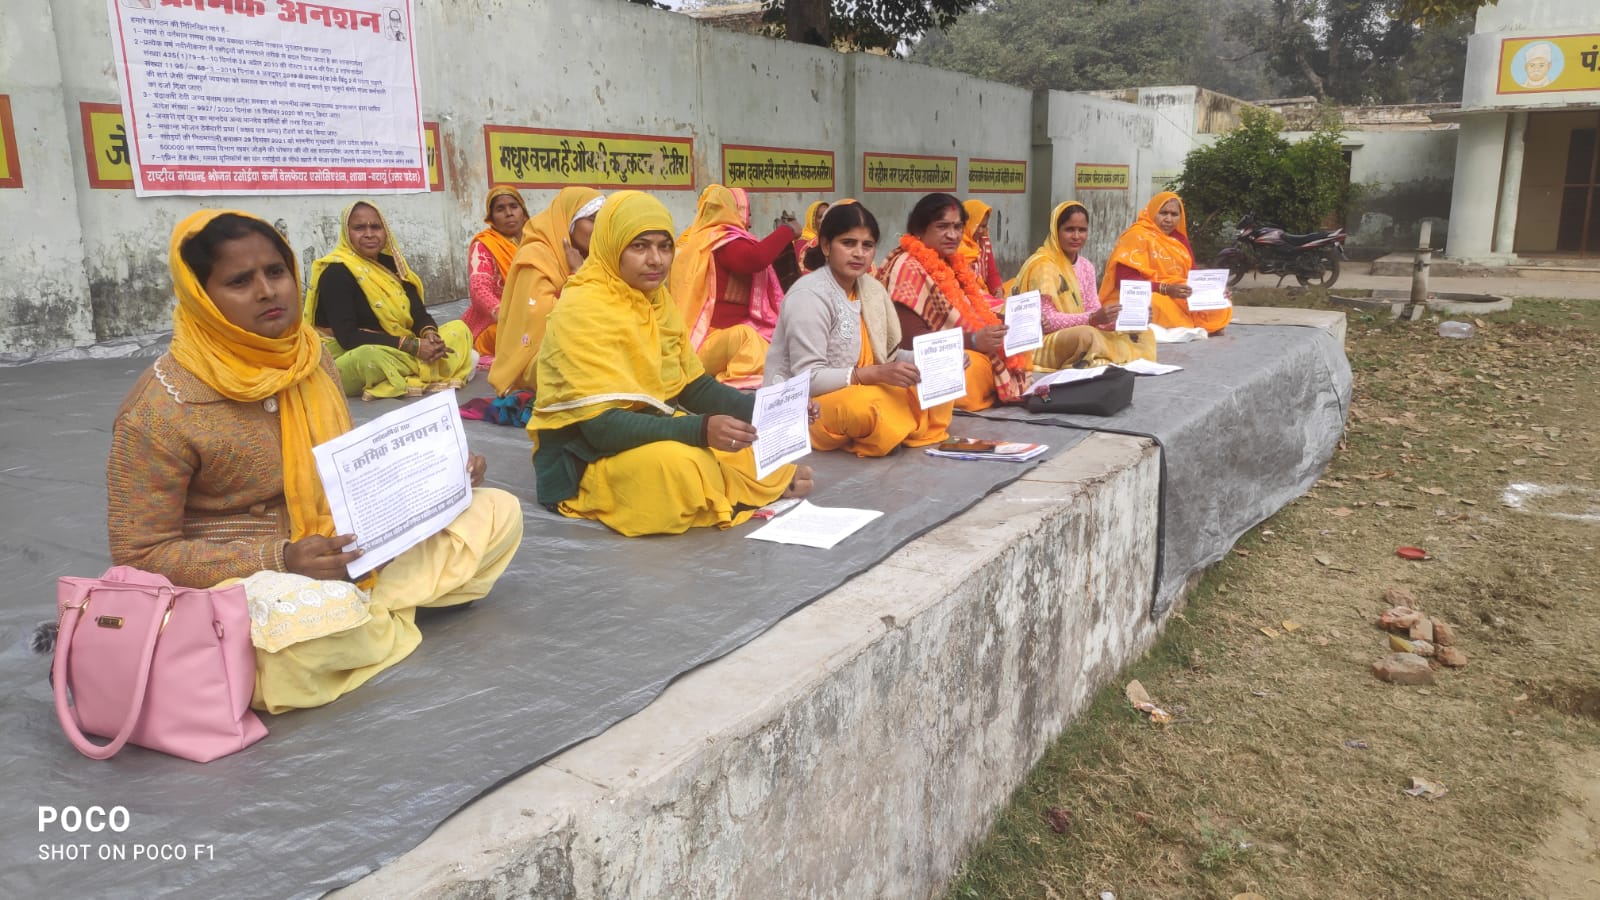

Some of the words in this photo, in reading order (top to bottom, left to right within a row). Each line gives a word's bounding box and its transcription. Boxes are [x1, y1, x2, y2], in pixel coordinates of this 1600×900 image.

[277, 0, 381, 33] अनशन
[146, 166, 175, 183] राष्ट्रीय
[176, 170, 207, 183] मध्यान्ह
[208, 168, 232, 182] भोजन
[233, 168, 260, 183] रसोईया
[261, 168, 278, 182] कर्मी
[279, 169, 308, 182] वेलफेयर
[349, 172, 367, 182] शाखा
[500, 146, 530, 179] मधुर
[530, 147, 561, 172] वचन
[560, 139, 572, 177] है
[352, 443, 389, 472] क्रमिक
[391, 421, 439, 451] अनशन
